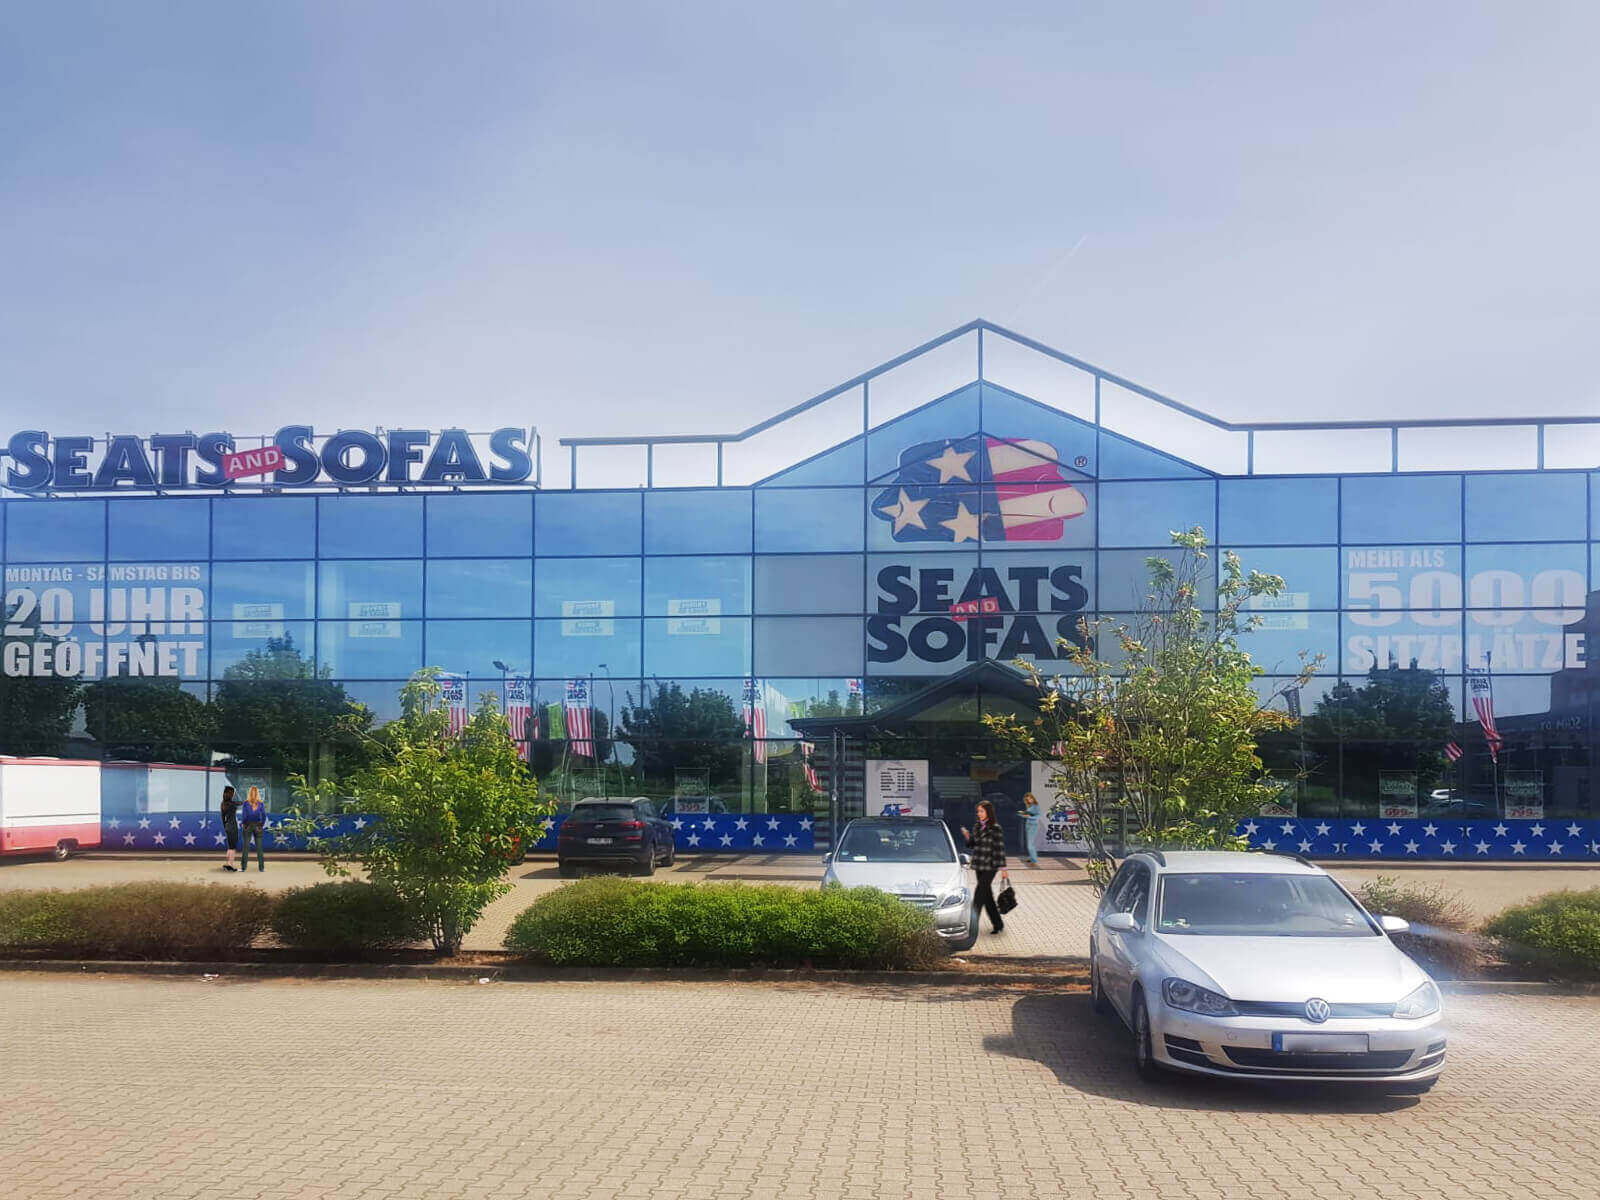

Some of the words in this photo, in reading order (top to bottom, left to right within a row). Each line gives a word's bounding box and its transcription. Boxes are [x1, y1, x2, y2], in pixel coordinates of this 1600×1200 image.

[6, 430, 236, 490] SEATS
[229, 450, 279, 472] AND
[272, 424, 532, 484] SOFAS
[5, 567, 73, 582] MONTAG
[172, 565, 200, 581] BIS
[1348, 550, 1406, 569] MEHR
[1409, 549, 1446, 568] ALS
[4, 587, 74, 636] 20
[90, 587, 205, 637] UHR
[877, 565, 1089, 614] SEATS
[956, 600, 996, 617] AND
[1347, 569, 1587, 628] 5000
[3, 636, 205, 678] GEÖFFNET
[866, 613, 1095, 663] SOFAS
[1347, 626, 1587, 671] SITZPLÄTZE
